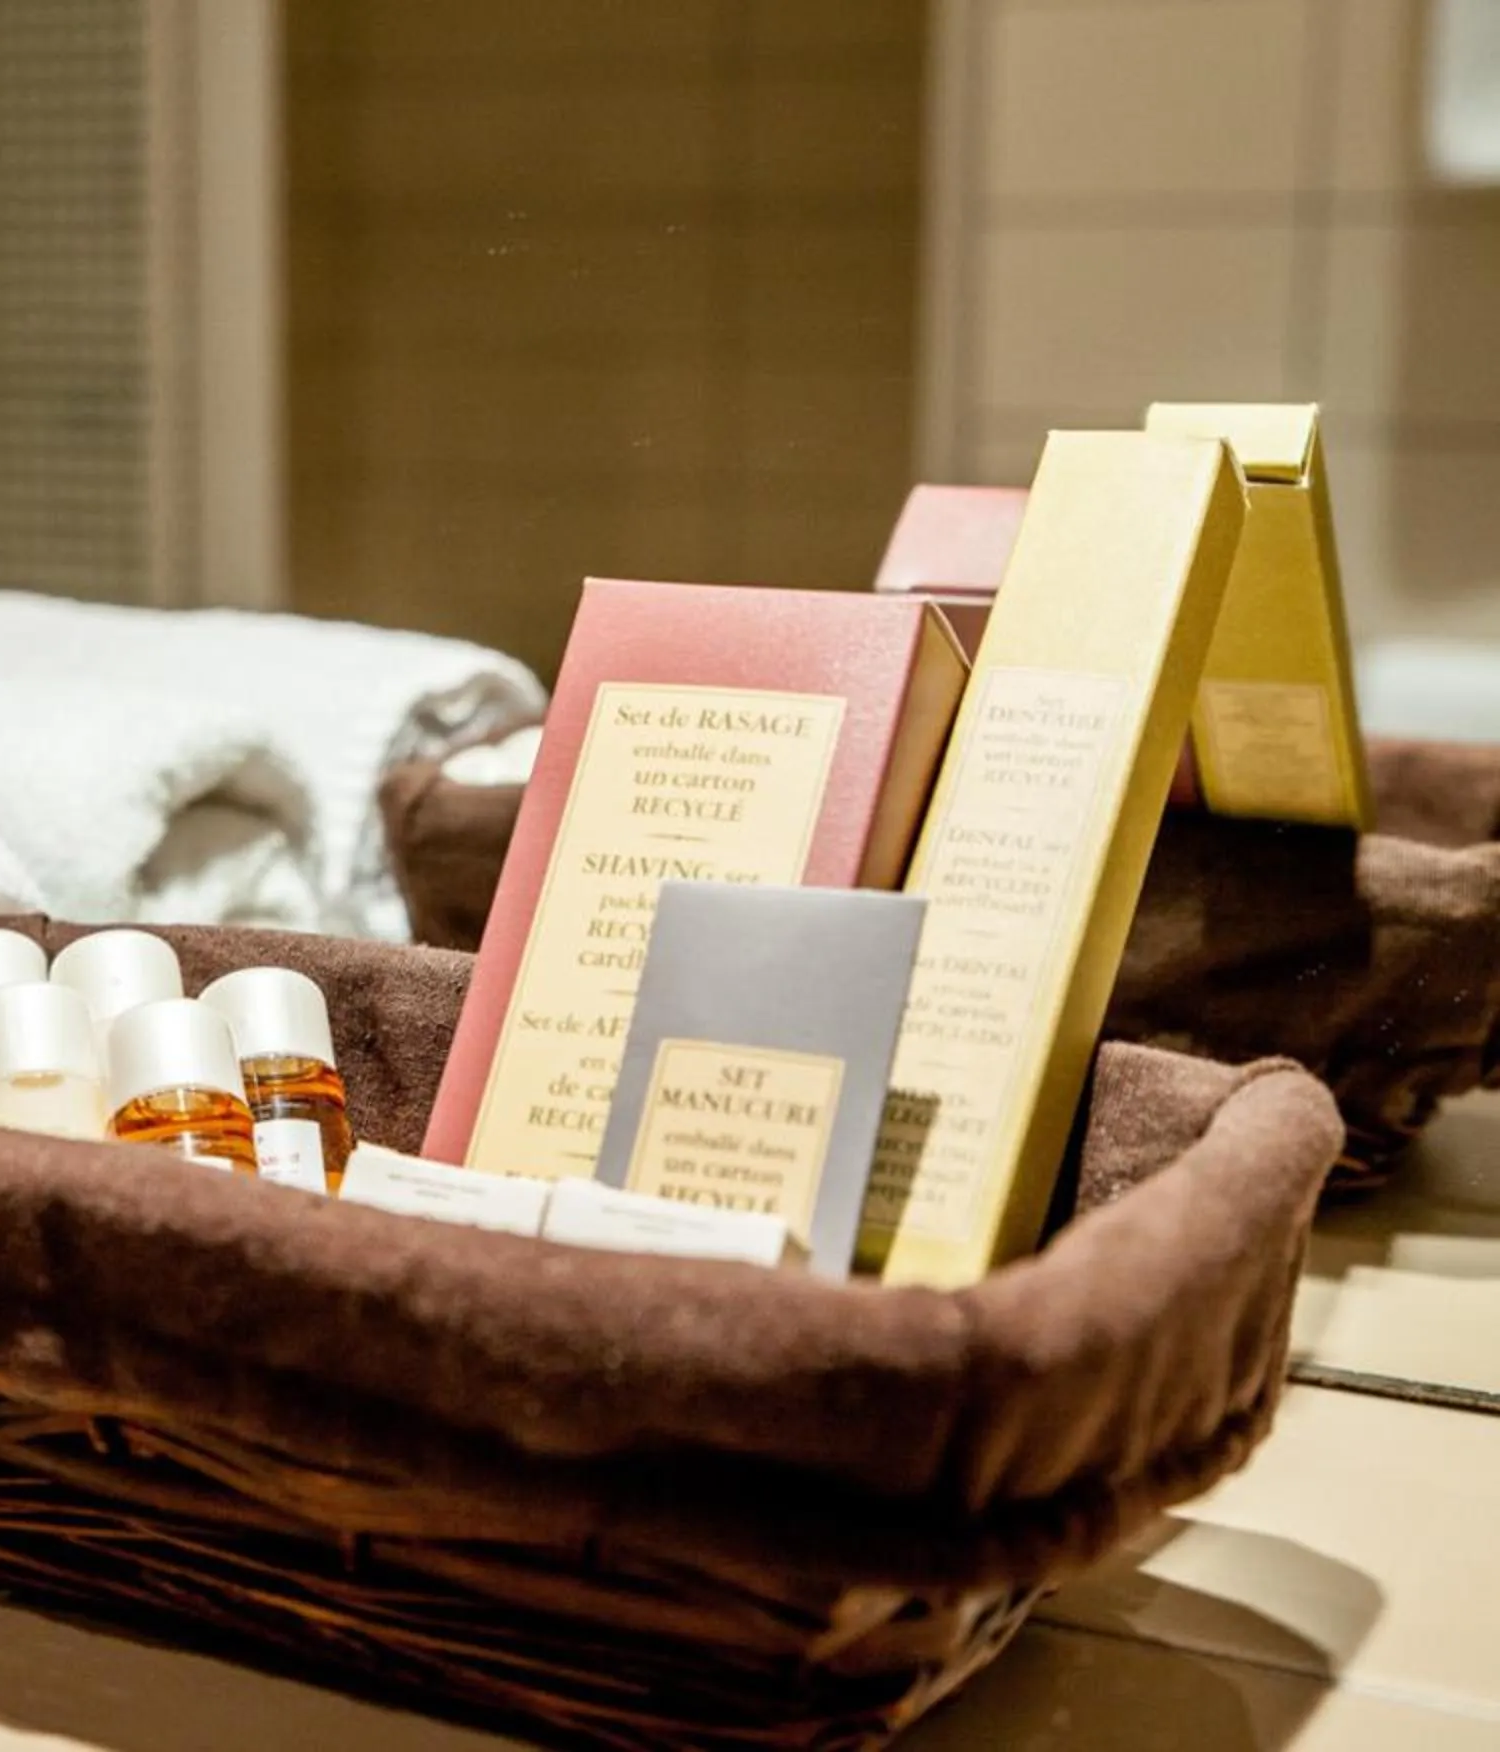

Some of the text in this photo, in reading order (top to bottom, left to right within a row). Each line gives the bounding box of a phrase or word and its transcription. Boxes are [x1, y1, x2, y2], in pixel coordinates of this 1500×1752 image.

[614, 703, 815, 737] Set de RASAGE
[632, 740, 773, 766] emballé dans
[633, 769, 756, 793] un carton
[631, 795, 746, 823] RECYCLÉ
[581, 852, 715, 882] SHAVING
[518, 1010, 551, 1031] Set
[556, 1012, 583, 1034] de
[547, 1071, 580, 1098] de
[717, 1065, 772, 1092] SET
[658, 1087, 820, 1127] MANUCURE
[748, 1139, 798, 1164] dans
[662, 1157, 785, 1187] un carton
